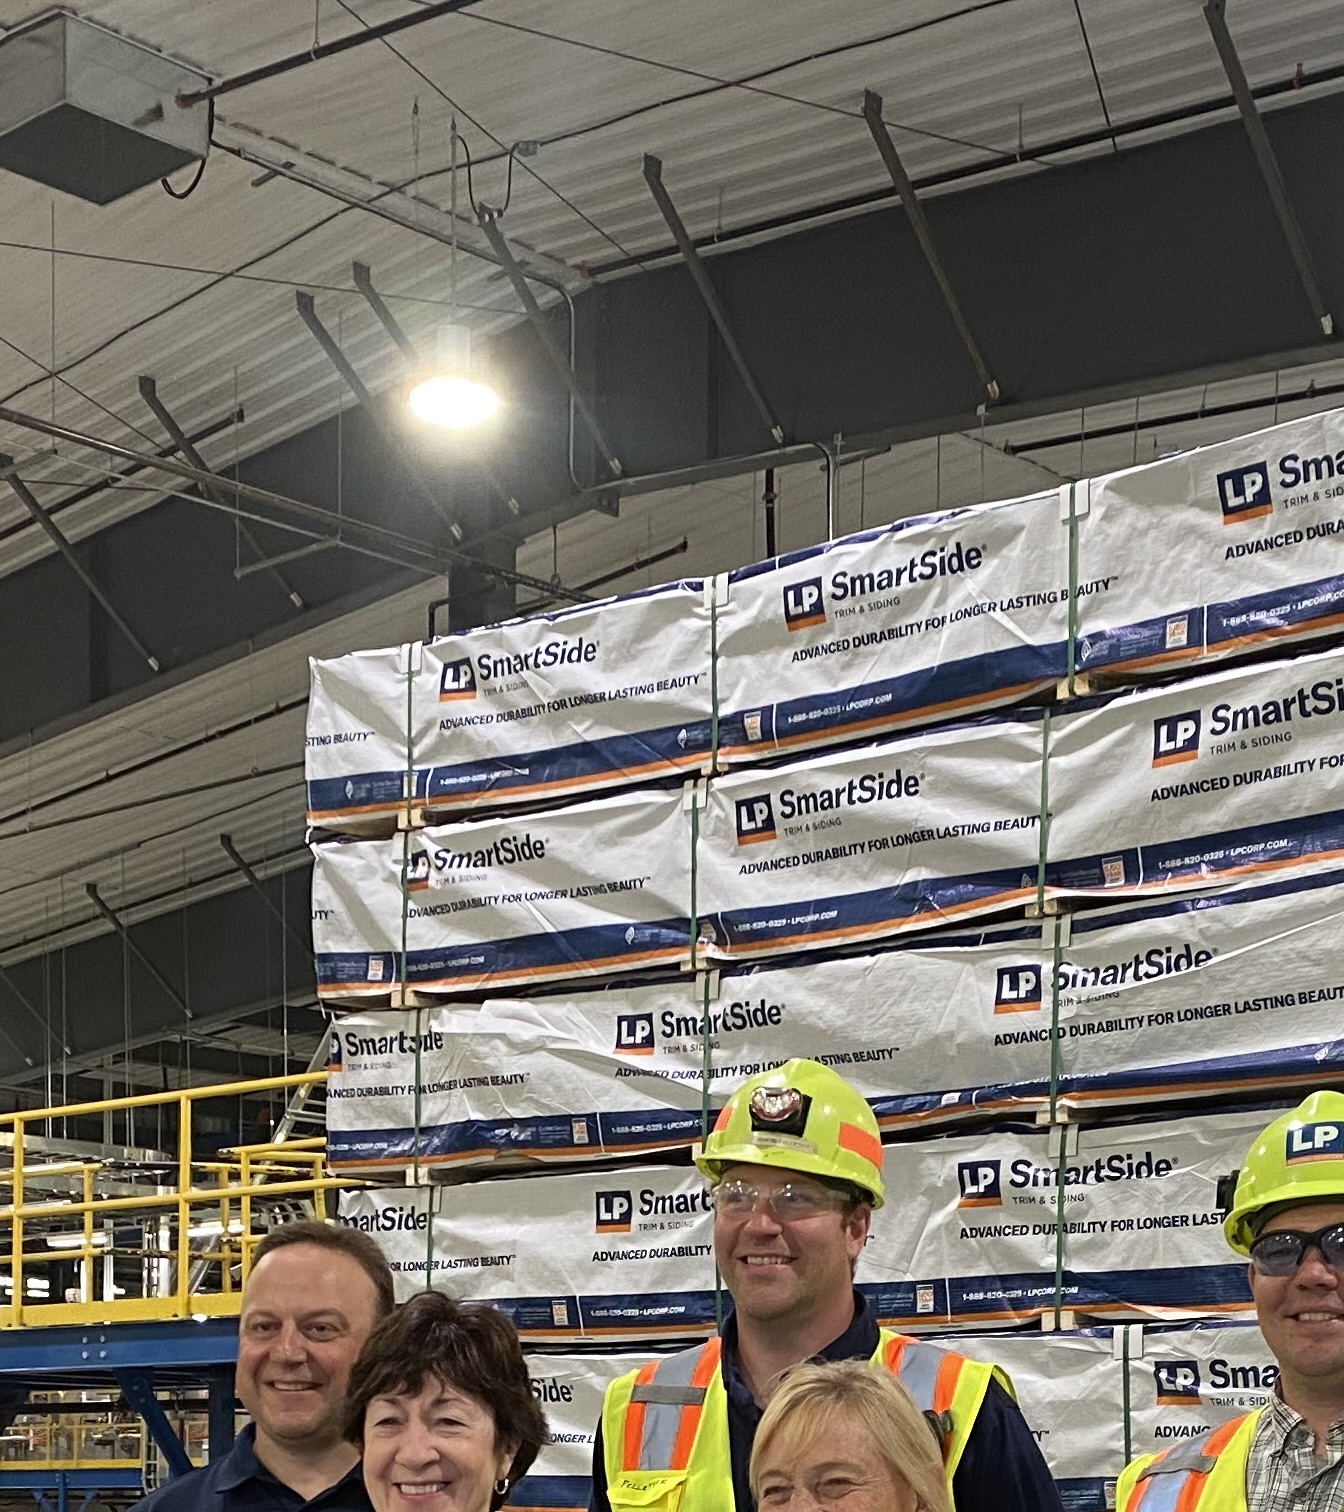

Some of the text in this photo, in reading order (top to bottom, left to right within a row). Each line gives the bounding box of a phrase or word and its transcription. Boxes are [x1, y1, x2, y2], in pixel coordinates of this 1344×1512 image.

[1224, 471, 1264, 506] LP
[1283, 496, 1309, 509] TRIM
[1225, 530, 1303, 560] ADVANCED
[787, 583, 822, 617] LP
[791, 591, 1057, 663] ADVANCED DURABILITY FOR LONGER LASTING
[444, 665, 472, 690] LP
[439, 683, 655, 731] ADVANCED DURABILITY FOR LONGER LASTING
[1159, 719, 1196, 752] LP
[1210, 732, 1292, 755] TRIM SIDING
[1151, 776, 1230, 802] ADVANCED
[1233, 759, 1316, 787] DURABILITY
[740, 801, 770, 831] LP
[739, 822, 991, 875] ADVANCED DURABILITY FOR LONGER LASTING
[501, 893, 523, 904] FOR
[524, 889, 568, 902] LONGER
[569, 884, 608, 898] LASTING
[1000, 971, 1036, 999] LP
[620, 1020, 650, 1045] LP
[994, 995, 1295, 1047] ADVANCD DURABILITY FOR LONGER LASTING
[739, 1061, 760, 1075] FOR
[1293, 1125, 1339, 1152] LP
[963, 1167, 995, 1194] LP
[599, 1194, 629, 1220] LP
[960, 1214, 1189, 1239] ADVANCED DURABILITY FOR LONGER
[441, 1257, 479, 1270] LASTING
[592, 1245, 712, 1263] ADVANCED DURABILITY
